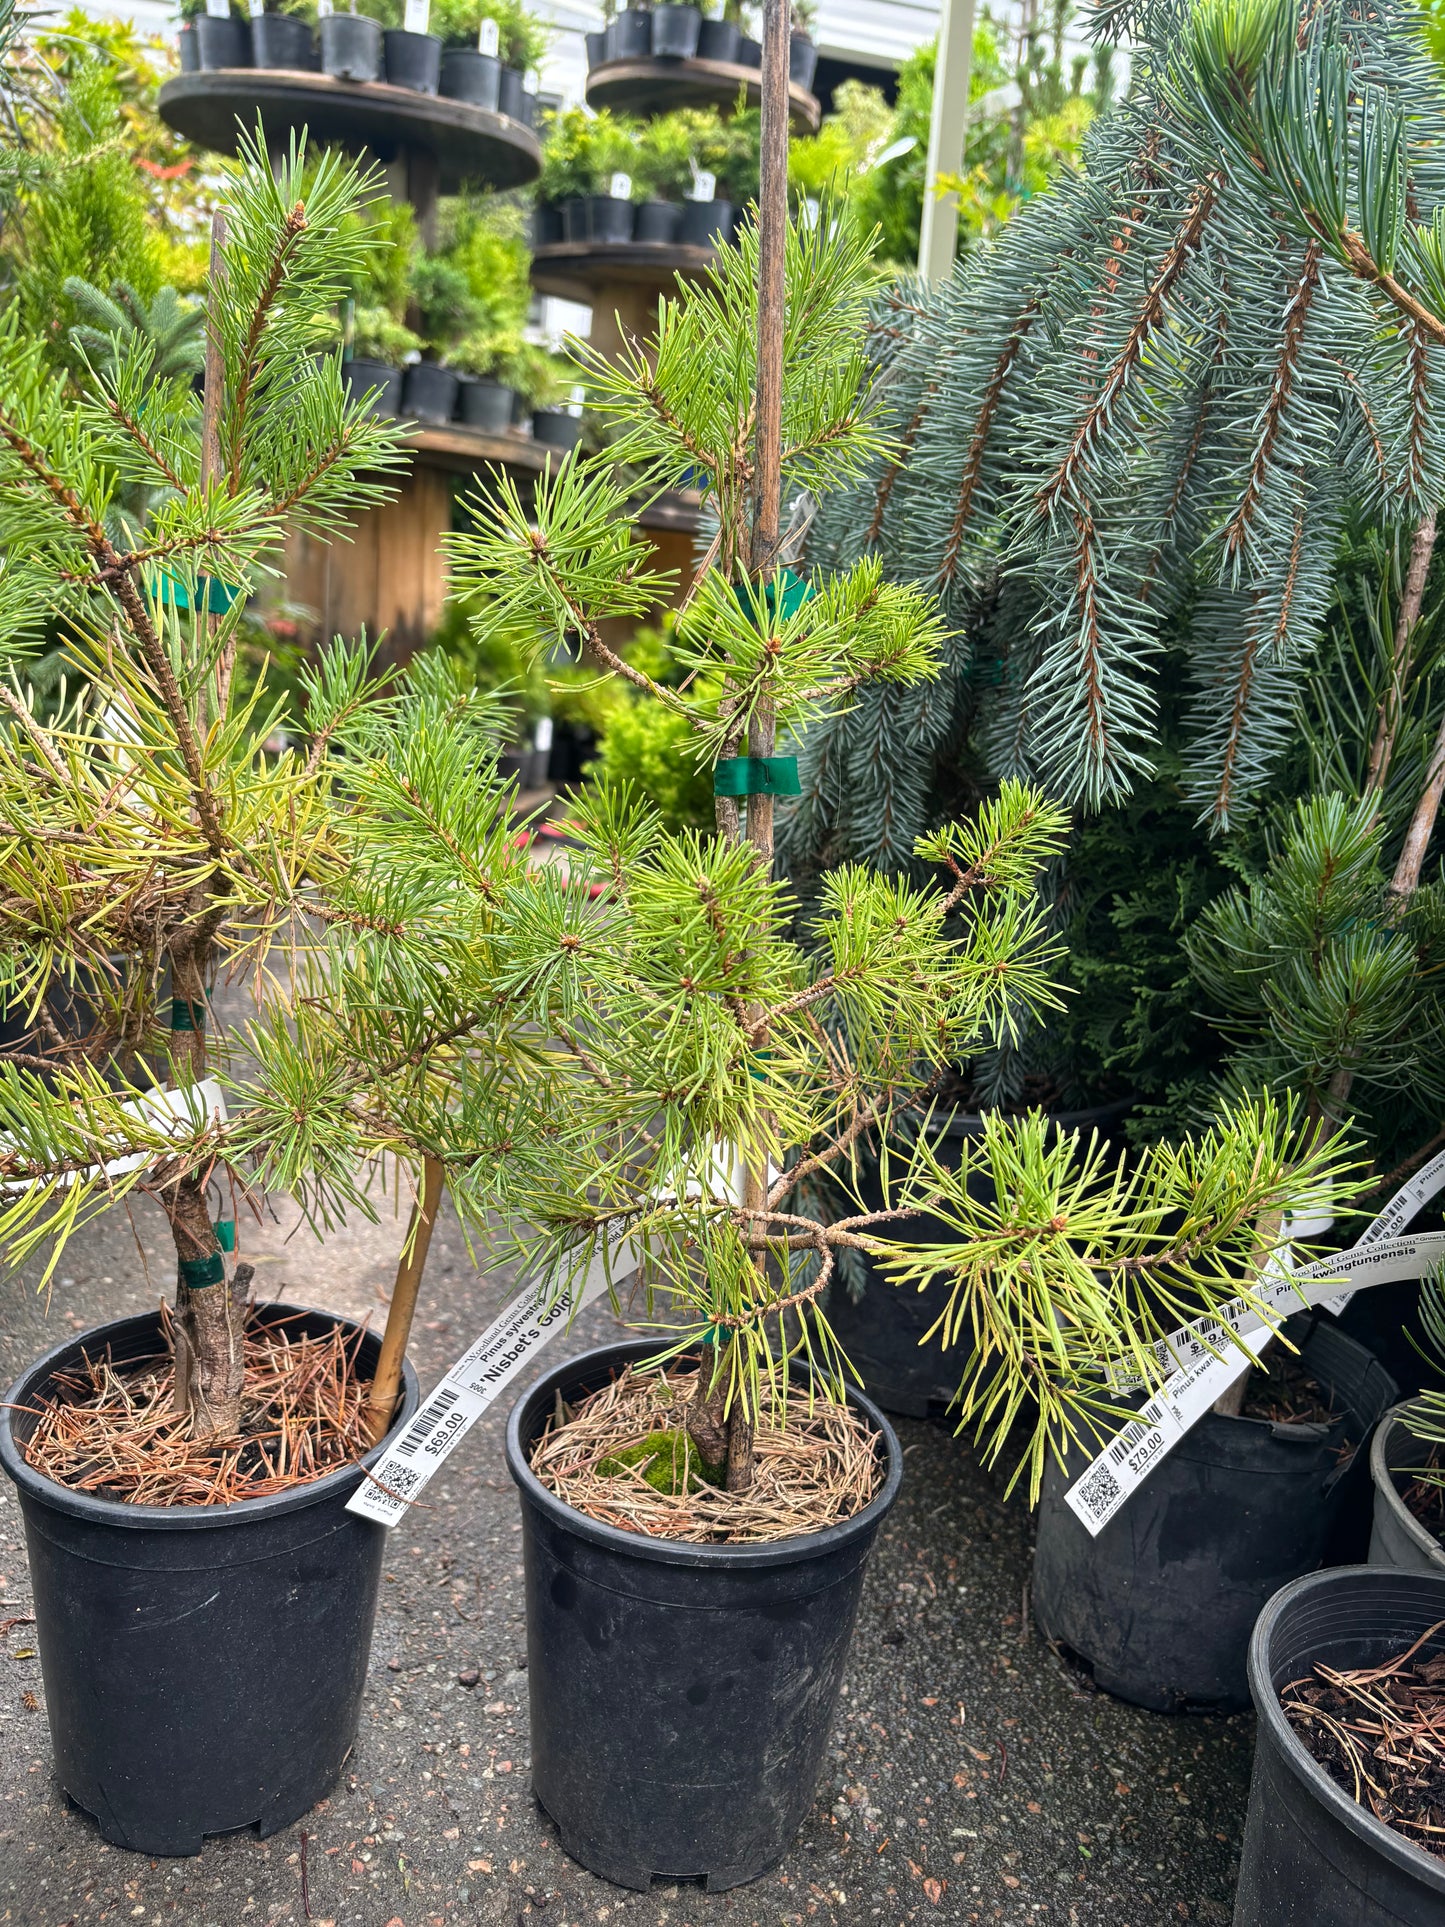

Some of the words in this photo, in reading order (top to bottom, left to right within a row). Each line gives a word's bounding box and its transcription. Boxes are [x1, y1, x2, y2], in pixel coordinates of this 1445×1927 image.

[1419, 1163, 1444, 1185] Pinus
[1312, 1247, 1417, 1280] kwangtungensis
[1336, 1250, 1364, 1264] Gems
[479, 1336, 508, 1363] Pinus
[505, 1297, 546, 1338] sylvestris
[498, 1307, 520, 1329] Gems
[1190, 1321, 1241, 1354] $9.0
[479, 1329, 541, 1383] 'Nisbet's
[1172, 1375, 1196, 1400] Pinus
[424, 1412, 464, 1456] $69.00
[1128, 1431, 1163, 1472] $79.00
